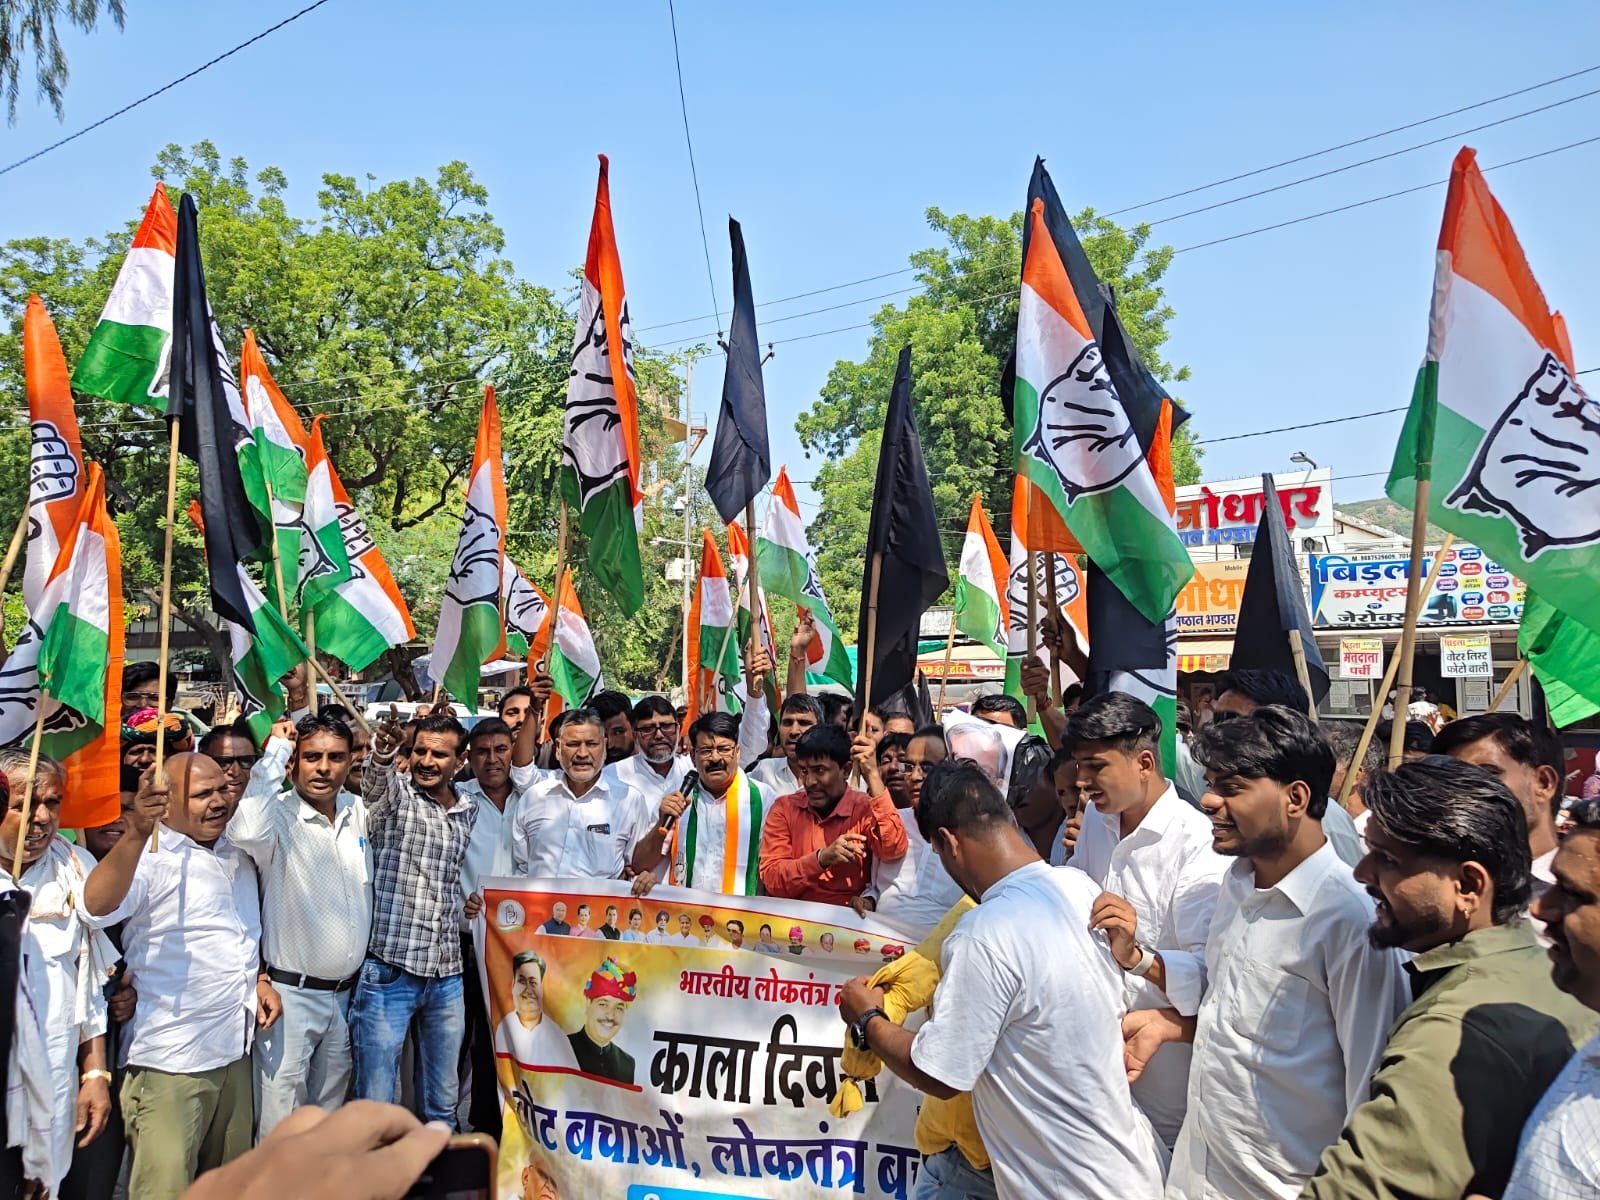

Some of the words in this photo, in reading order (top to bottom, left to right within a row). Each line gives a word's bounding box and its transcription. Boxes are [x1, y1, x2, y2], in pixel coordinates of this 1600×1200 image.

[1317, 555, 1430, 585] बिड़ला
[1206, 614, 1236, 625] भण्डार
[1343, 652, 1379, 663] मतदाता
[1447, 650, 1466, 661] वोटर
[1466, 650, 1488, 661] लिस्ट
[1350, 664, 1371, 675] पर्ची
[1447, 662, 1467, 673] फोटो
[1468, 662, 1489, 673] वाली
[679, 964, 751, 999] भारतीय
[755, 967, 831, 1006] लोकतंत्र
[650, 1030, 760, 1104] काला
[763, 1014, 879, 1108] दिव
[707, 1118, 868, 1194] लोकतंत्र
